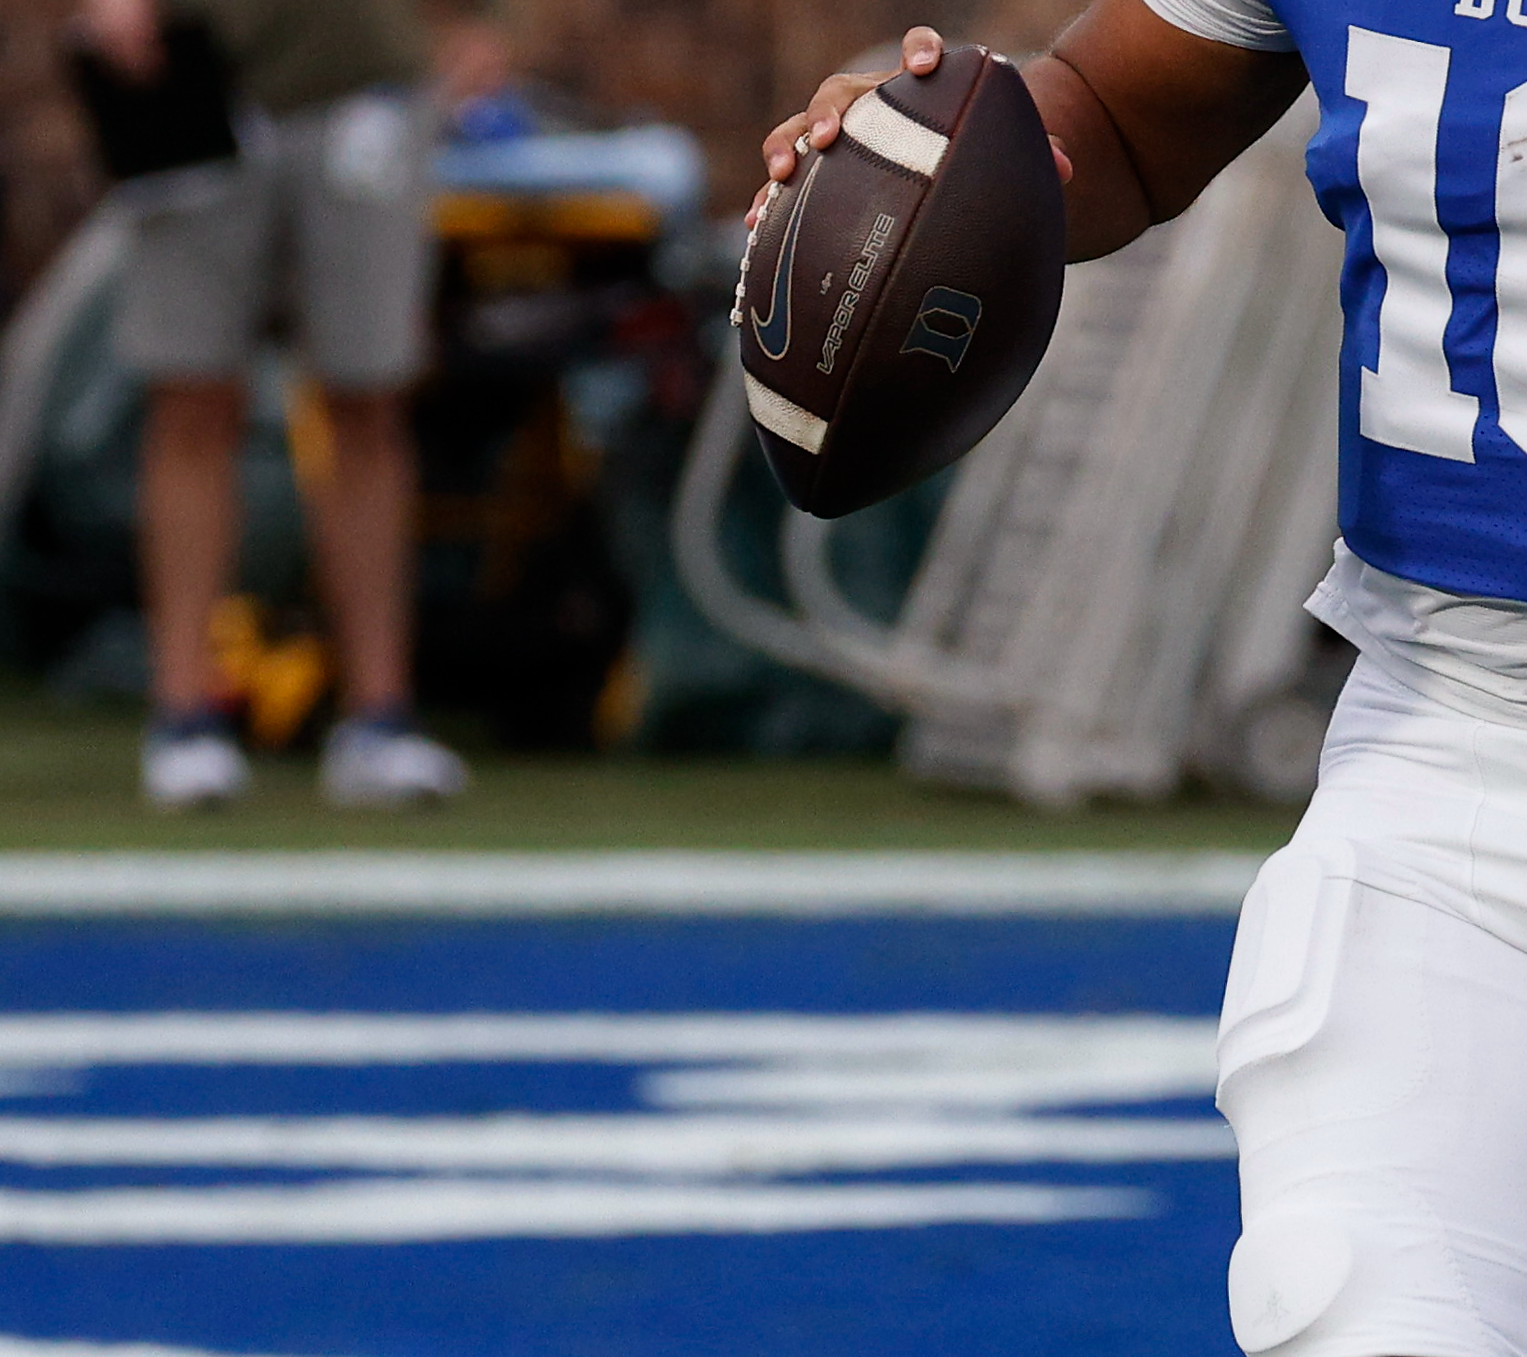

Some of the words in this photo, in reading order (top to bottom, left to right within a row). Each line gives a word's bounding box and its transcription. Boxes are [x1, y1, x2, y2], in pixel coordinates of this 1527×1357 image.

[816, 290, 860, 375] VAPOR
[848, 213, 895, 292] ELITE
[899, 285, 983, 373] D
